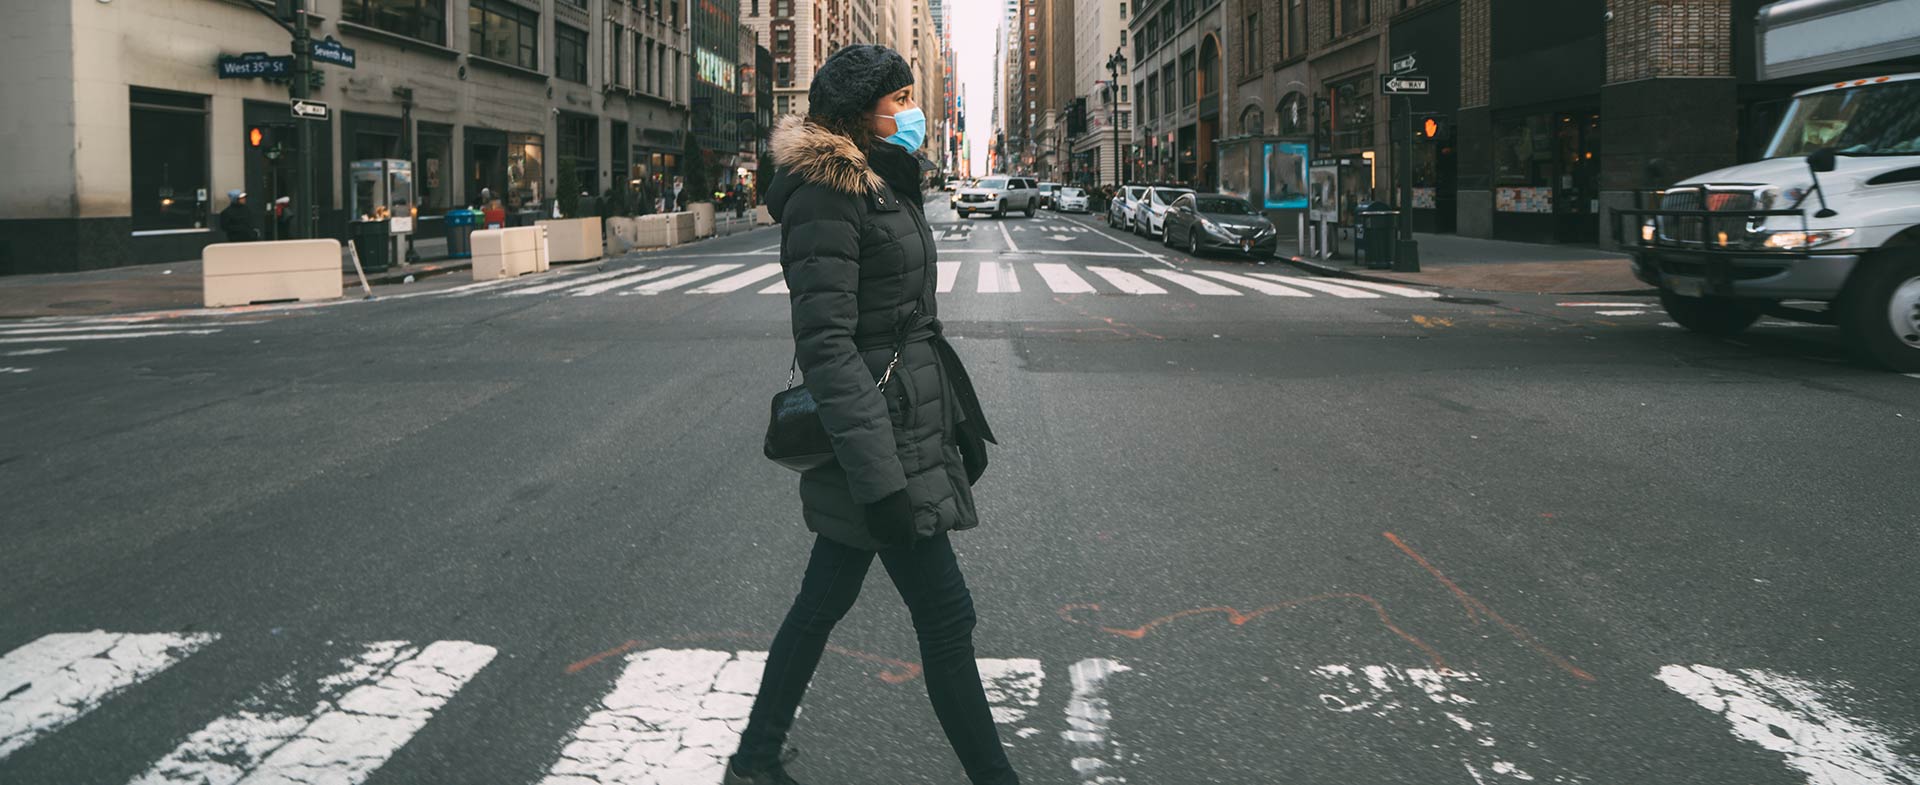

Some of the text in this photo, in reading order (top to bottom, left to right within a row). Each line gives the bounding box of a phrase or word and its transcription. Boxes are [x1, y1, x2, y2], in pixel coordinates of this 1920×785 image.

[314, 45, 340, 60] Seventh
[341, 52, 353, 64] Ave
[224, 61, 285, 73] West 35th St
